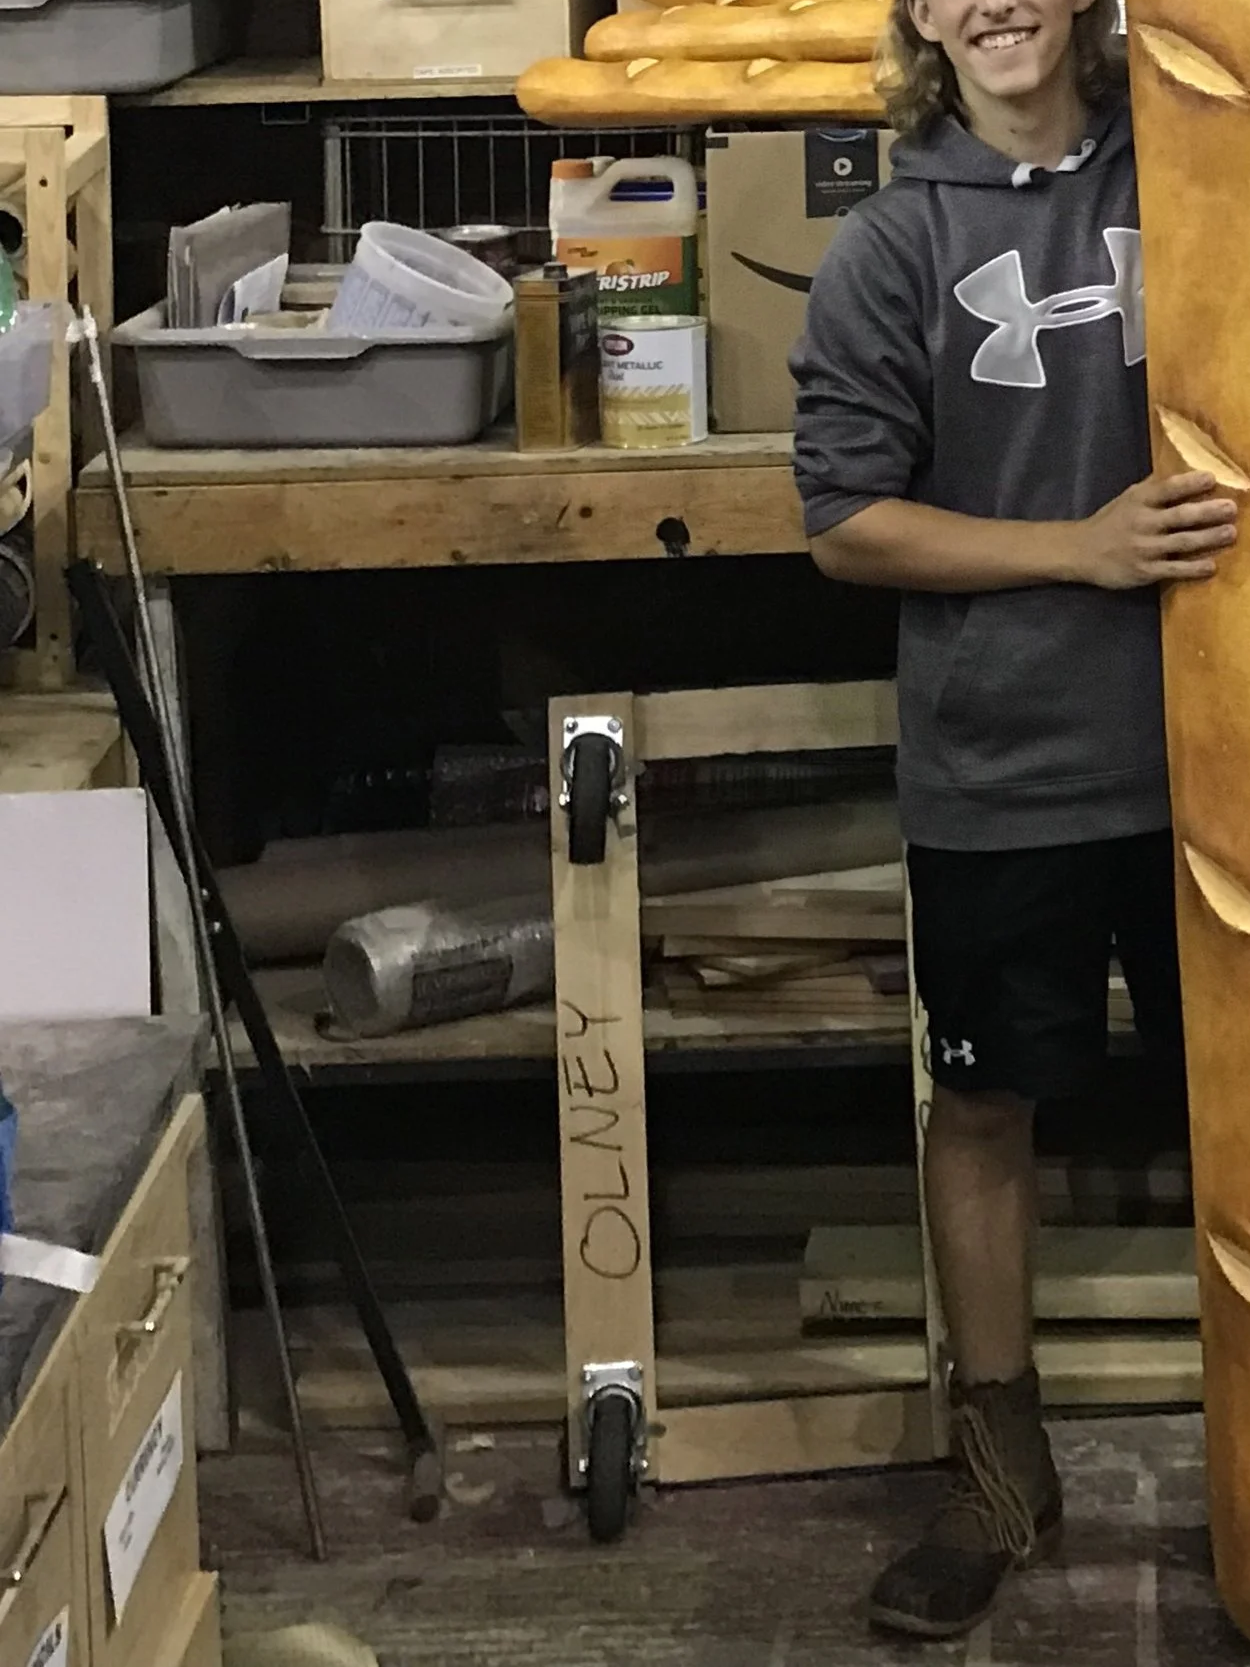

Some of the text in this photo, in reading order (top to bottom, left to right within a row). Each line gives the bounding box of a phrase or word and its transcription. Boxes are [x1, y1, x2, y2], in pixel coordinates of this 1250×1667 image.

[596, 271, 671, 292] RISTRIP
[640, 305, 663, 315] GEL
[617, 361, 664, 370] METALLIC
[560, 999, 641, 1280] OLNEY
